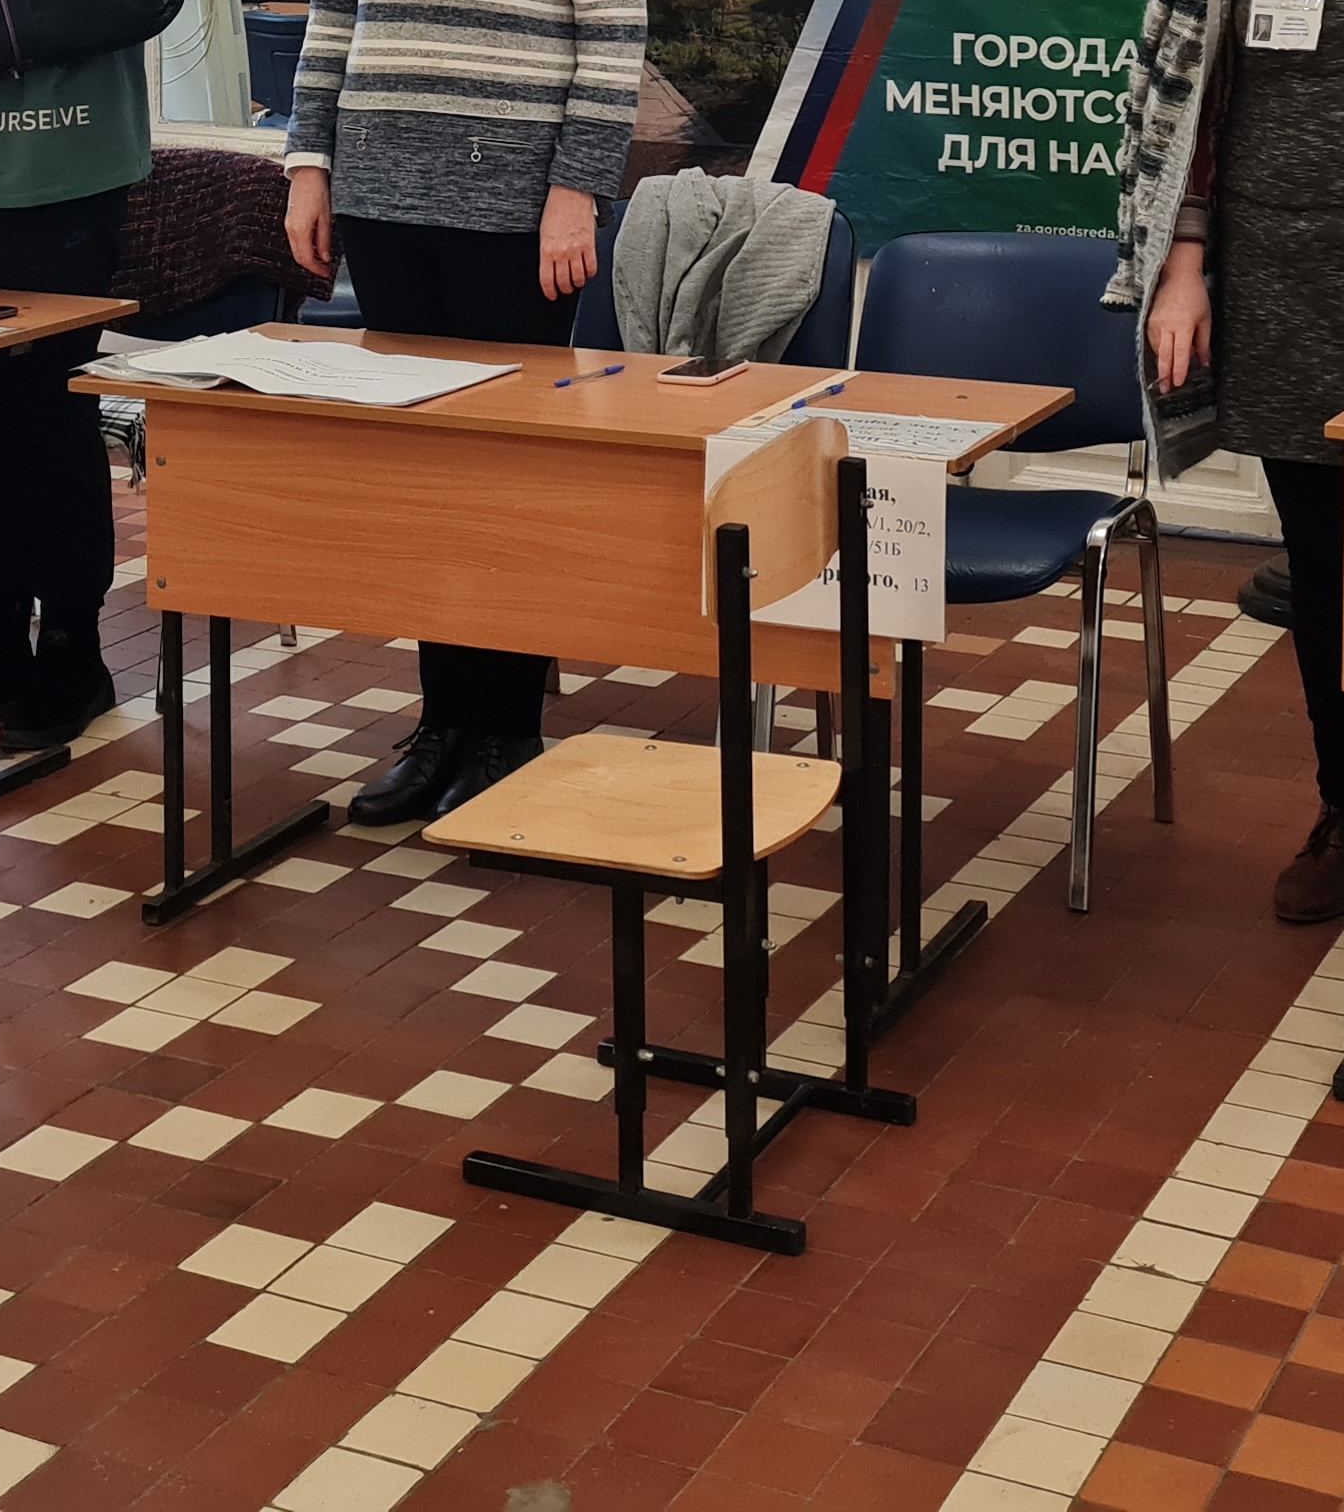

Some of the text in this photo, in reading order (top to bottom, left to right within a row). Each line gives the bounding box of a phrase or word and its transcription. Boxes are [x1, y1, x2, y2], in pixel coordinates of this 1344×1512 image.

[952, 32, 1140, 78] ГОРОДА
[938, 133, 1126, 176] ДЛЯ НА
[1016, 224, 1119, 239] za.gorodsreda.
[867, 486, 897, 506] ая,
[895, 518, 931, 537] 20/2,
[869, 540, 902, 557] /51Б
[914, 577, 929, 593] 13
